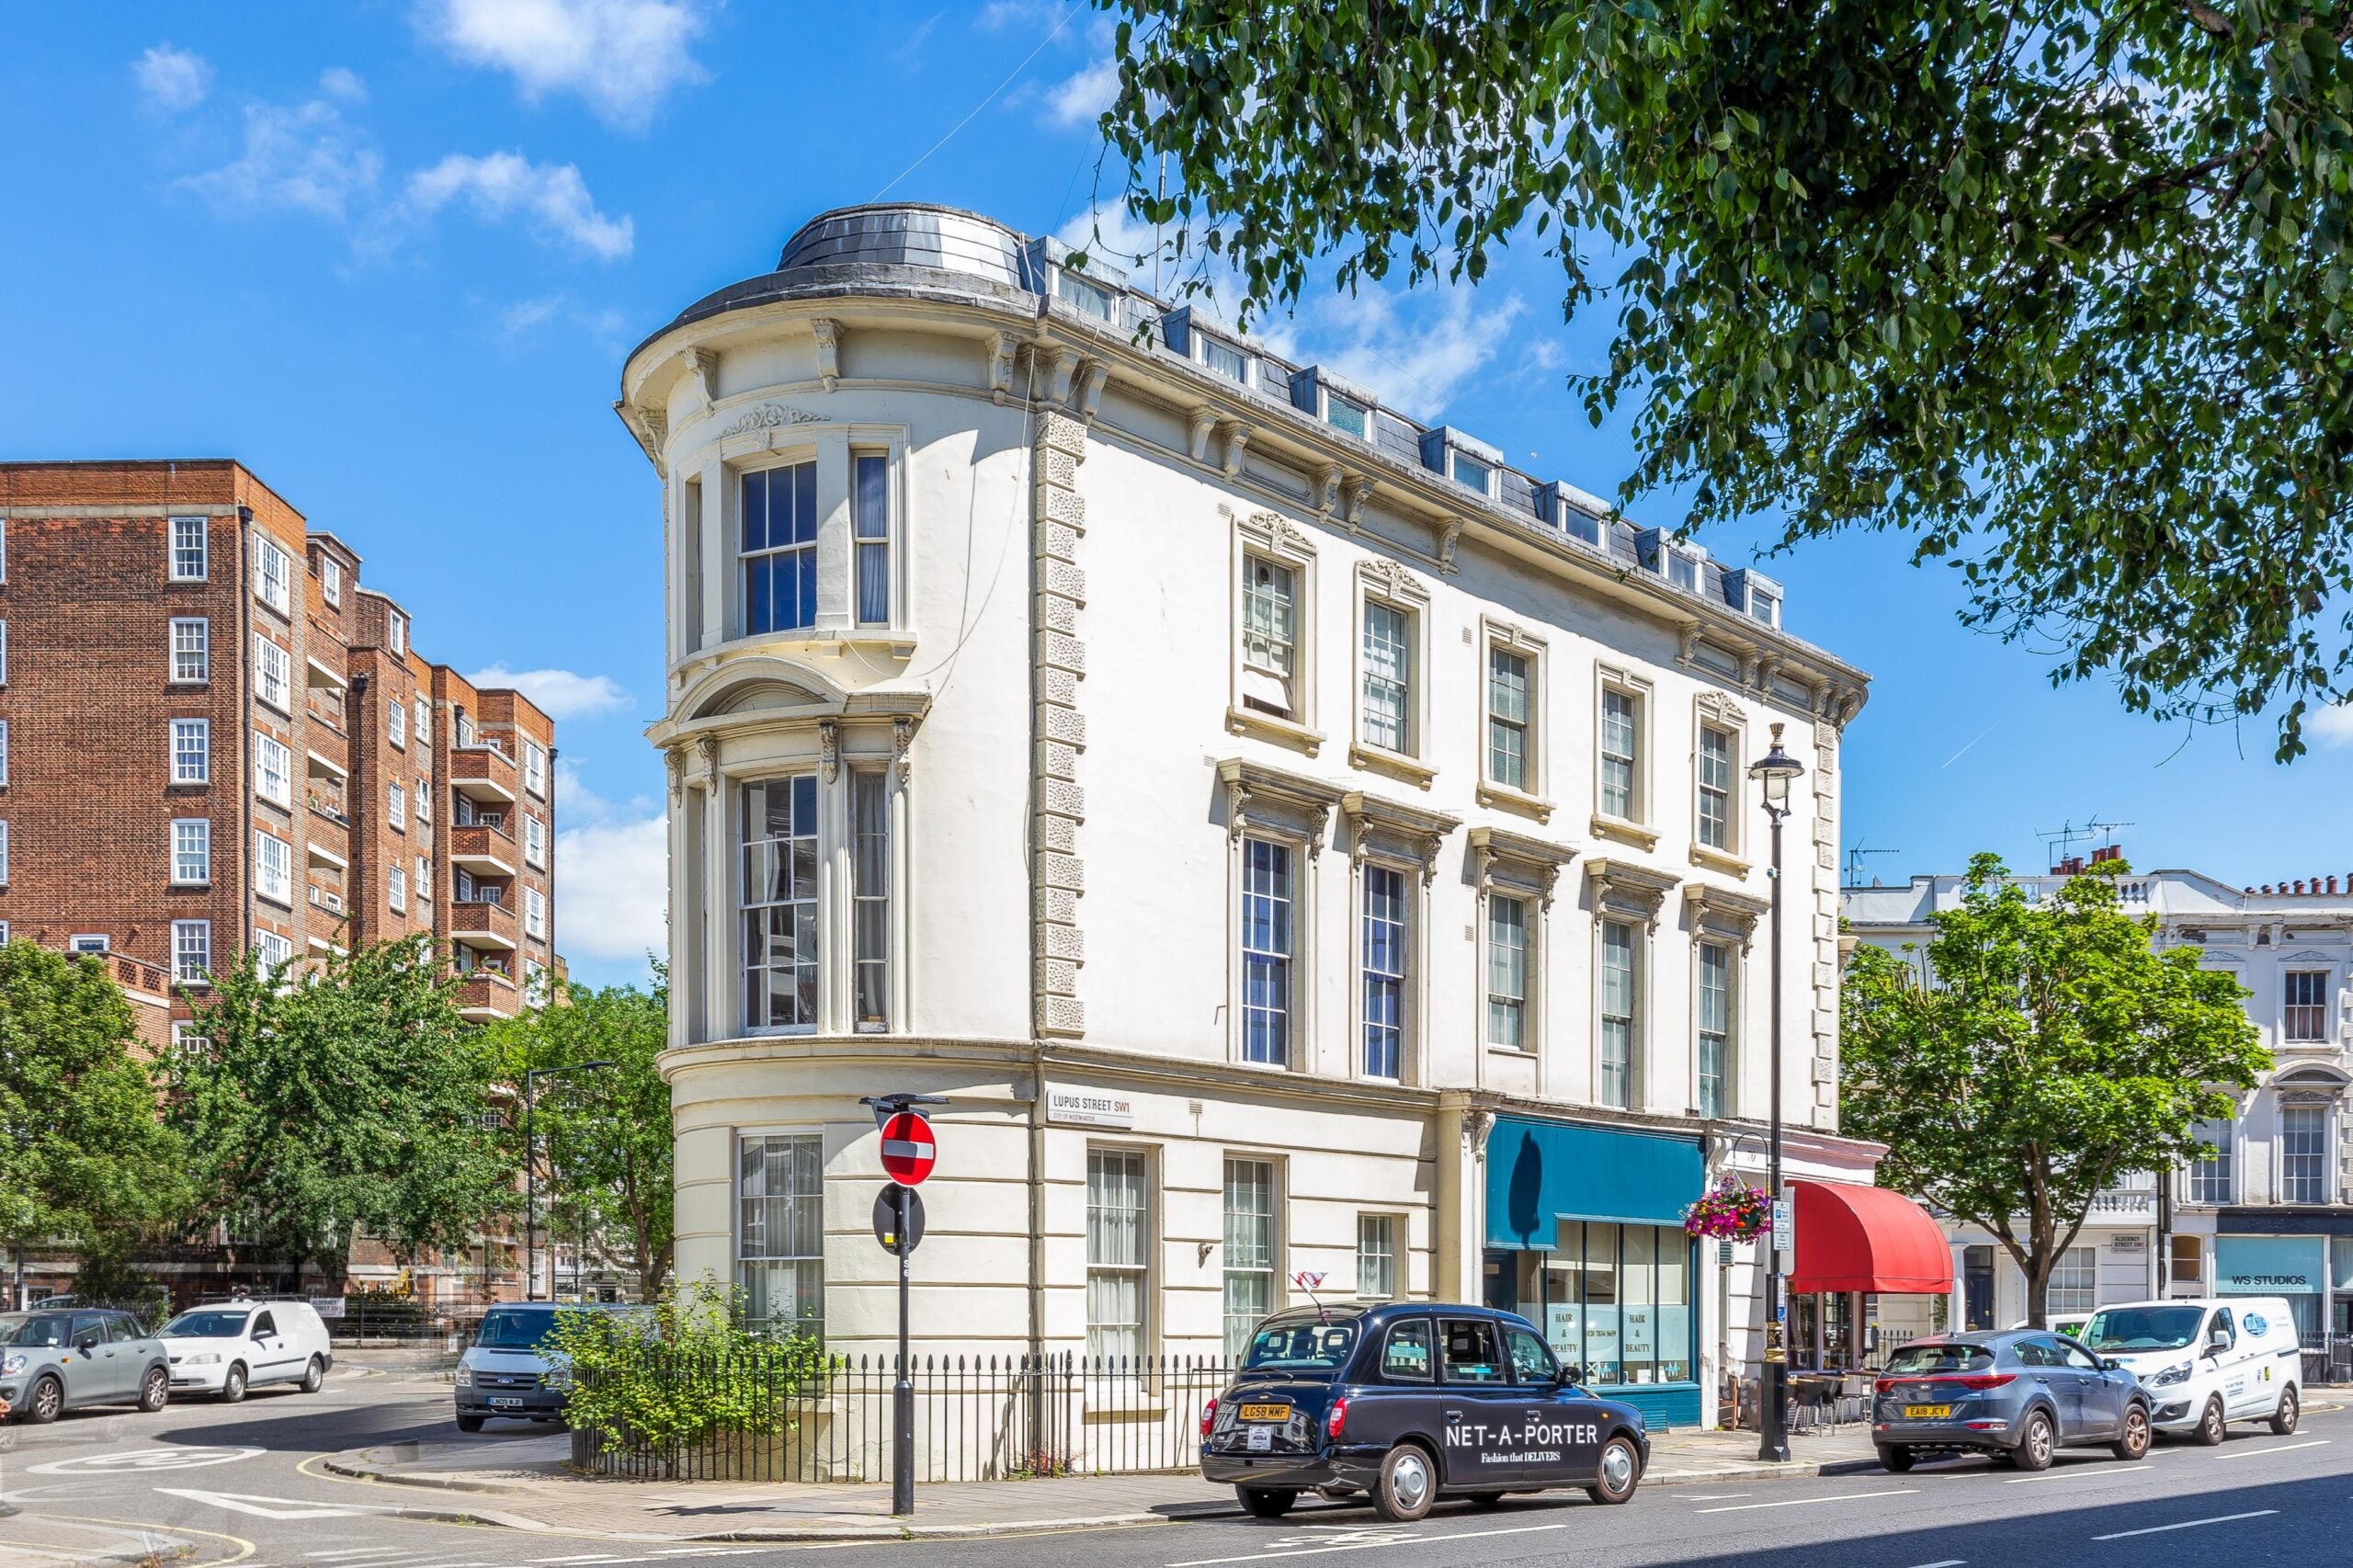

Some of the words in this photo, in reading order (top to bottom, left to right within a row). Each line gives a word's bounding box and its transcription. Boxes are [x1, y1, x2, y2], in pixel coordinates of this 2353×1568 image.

[1053, 1095, 1080, 1108] LUPUS
[1082, 1097, 1111, 1111] STREET
[1114, 1101, 1130, 1113] SW1
[2232, 1275, 2251, 1286] WS
[2254, 1275, 2307, 1286] STUDIOS
[1555, 1313, 1573, 1323] HAIR
[1629, 1314, 1645, 1324] HAIR
[1562, 1329, 1567, 1337] &
[1635, 1329, 1641, 1337] &
[1551, 1344, 1578, 1353] BEAUTY
[1625, 1344, 1651, 1353] BEAUTY
[1245, 1406, 1267, 1417] LG58
[1910, 1407, 1927, 1415] EA18
[1929, 1407, 1946, 1415] JCY
[1446, 1425, 1598, 1447] NET-A-PORTER
[1481, 1452, 1509, 1463] Fashion
[1509, 1451, 1524, 1462] that
[1524, 1451, 1561, 1462] DELIVERS
